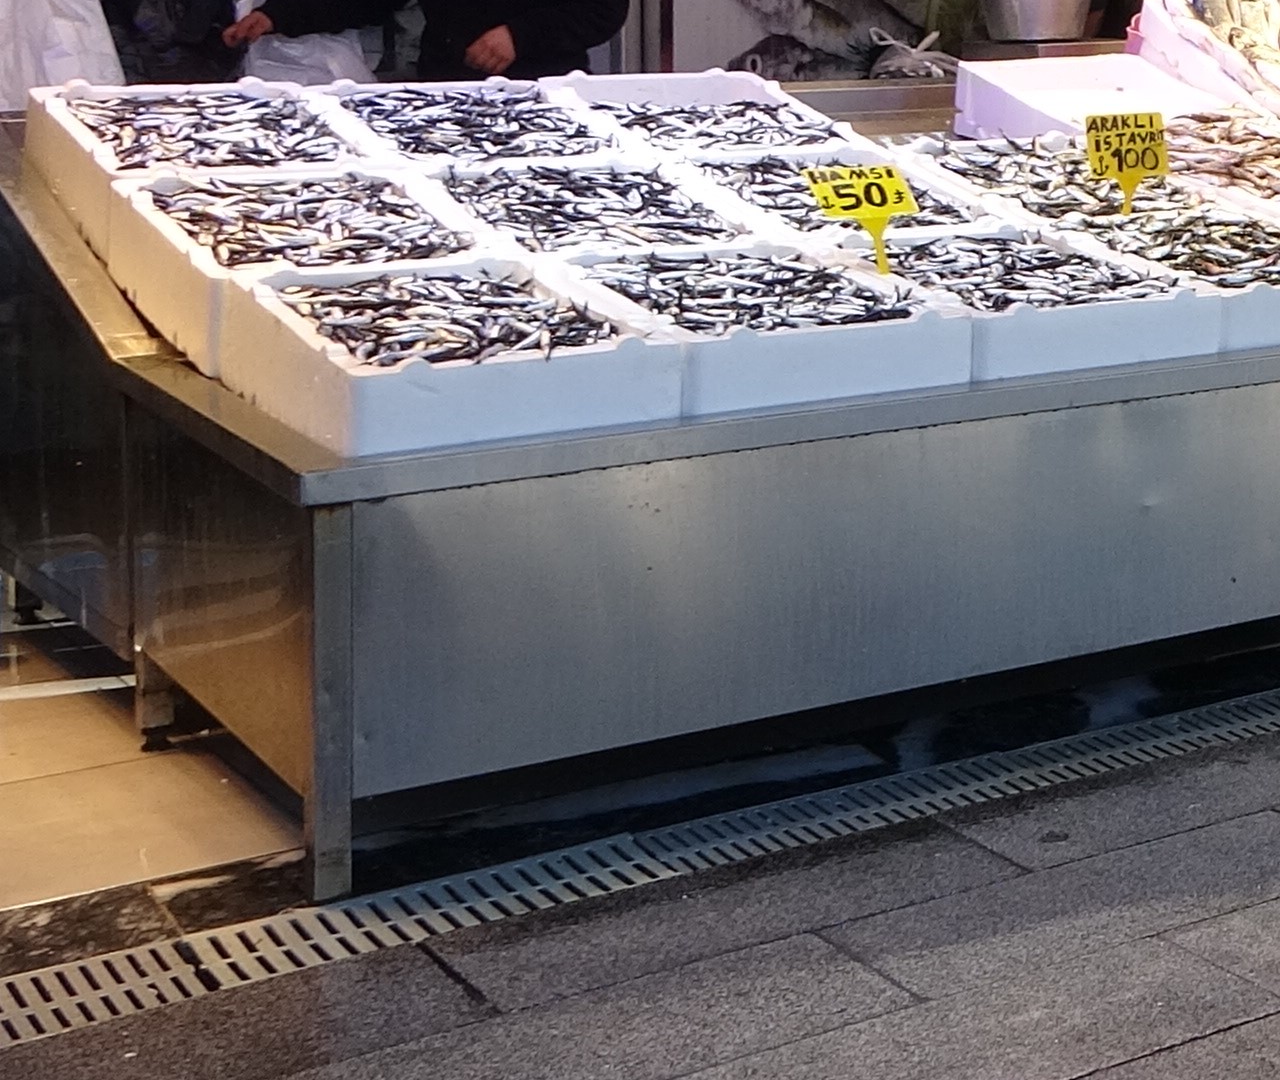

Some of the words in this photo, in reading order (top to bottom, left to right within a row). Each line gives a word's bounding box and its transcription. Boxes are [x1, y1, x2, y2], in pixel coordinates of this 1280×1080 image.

[1086, 114, 1154, 134] ARAKLI
[1110, 146, 1160, 173] 100
[831, 181, 889, 211] 50
